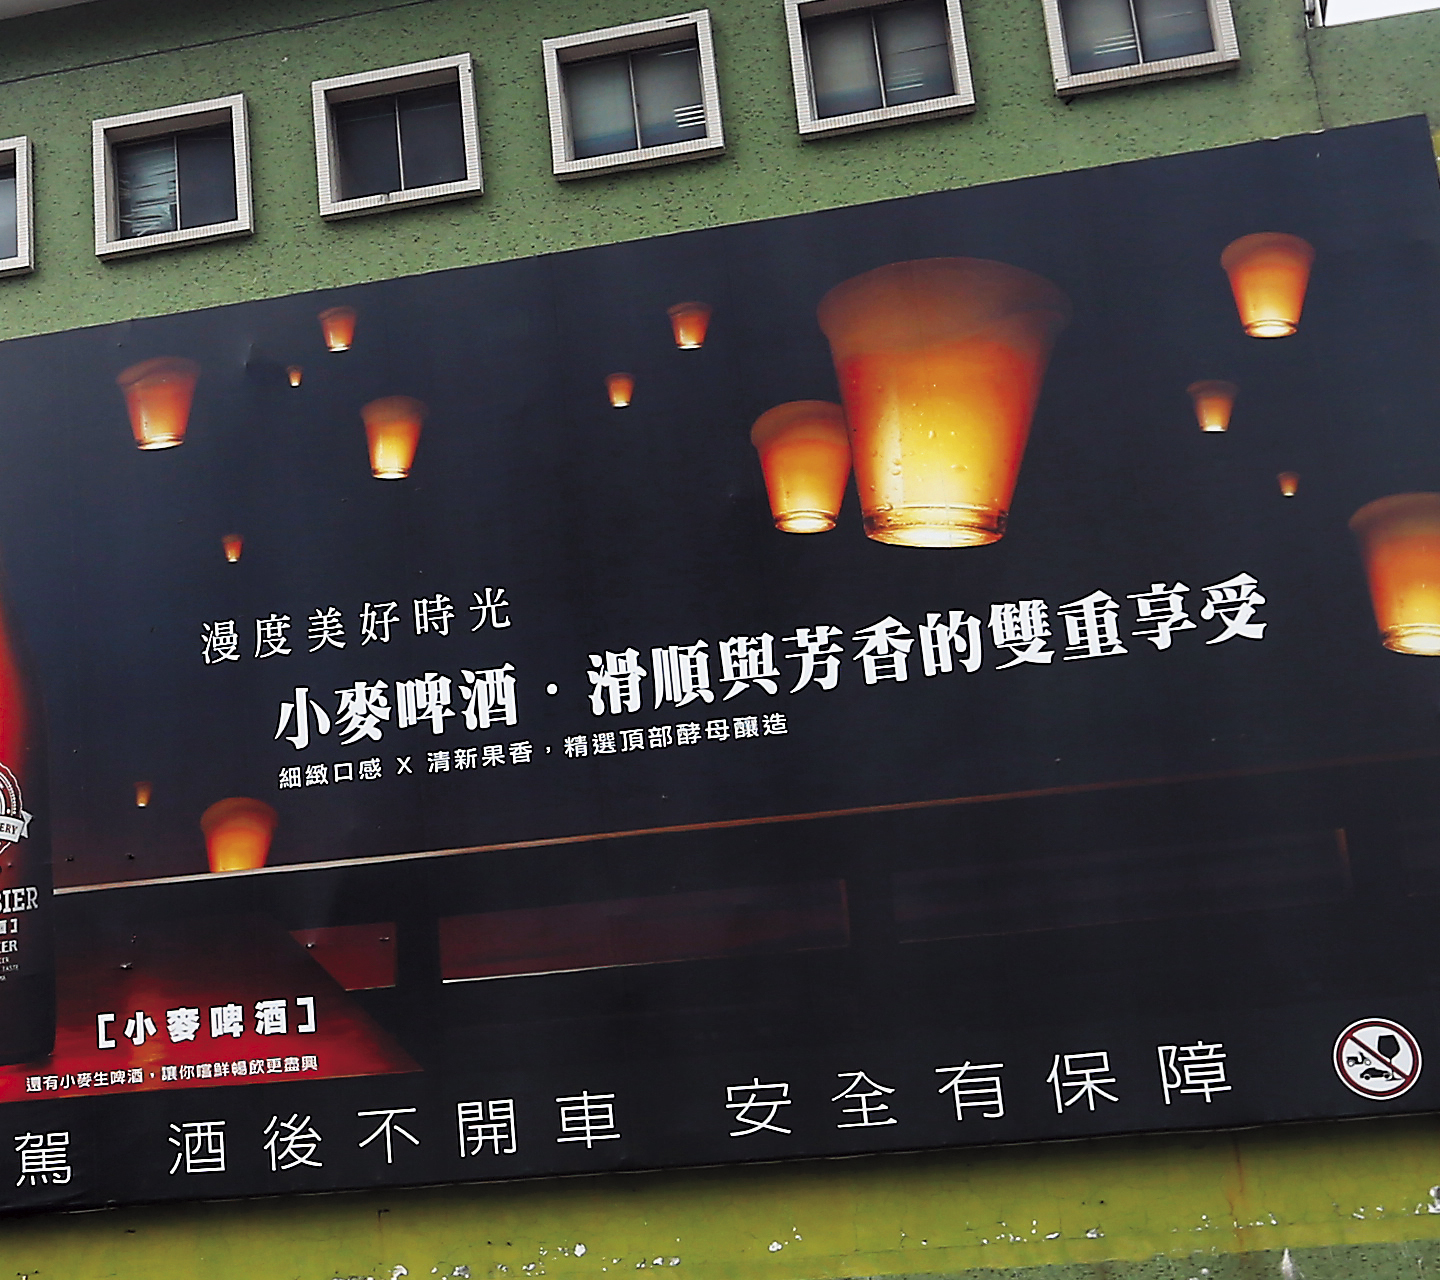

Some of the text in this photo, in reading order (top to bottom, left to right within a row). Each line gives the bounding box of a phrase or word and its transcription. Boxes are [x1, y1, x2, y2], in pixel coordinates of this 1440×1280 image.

[201, 586, 511, 665] 漫度美好時光
[278, 757, 382, 789] 細緻口感
[169, 1090, 622, 1175] 酒後不開車
[723, 1039, 1233, 1138] 安全有保障
